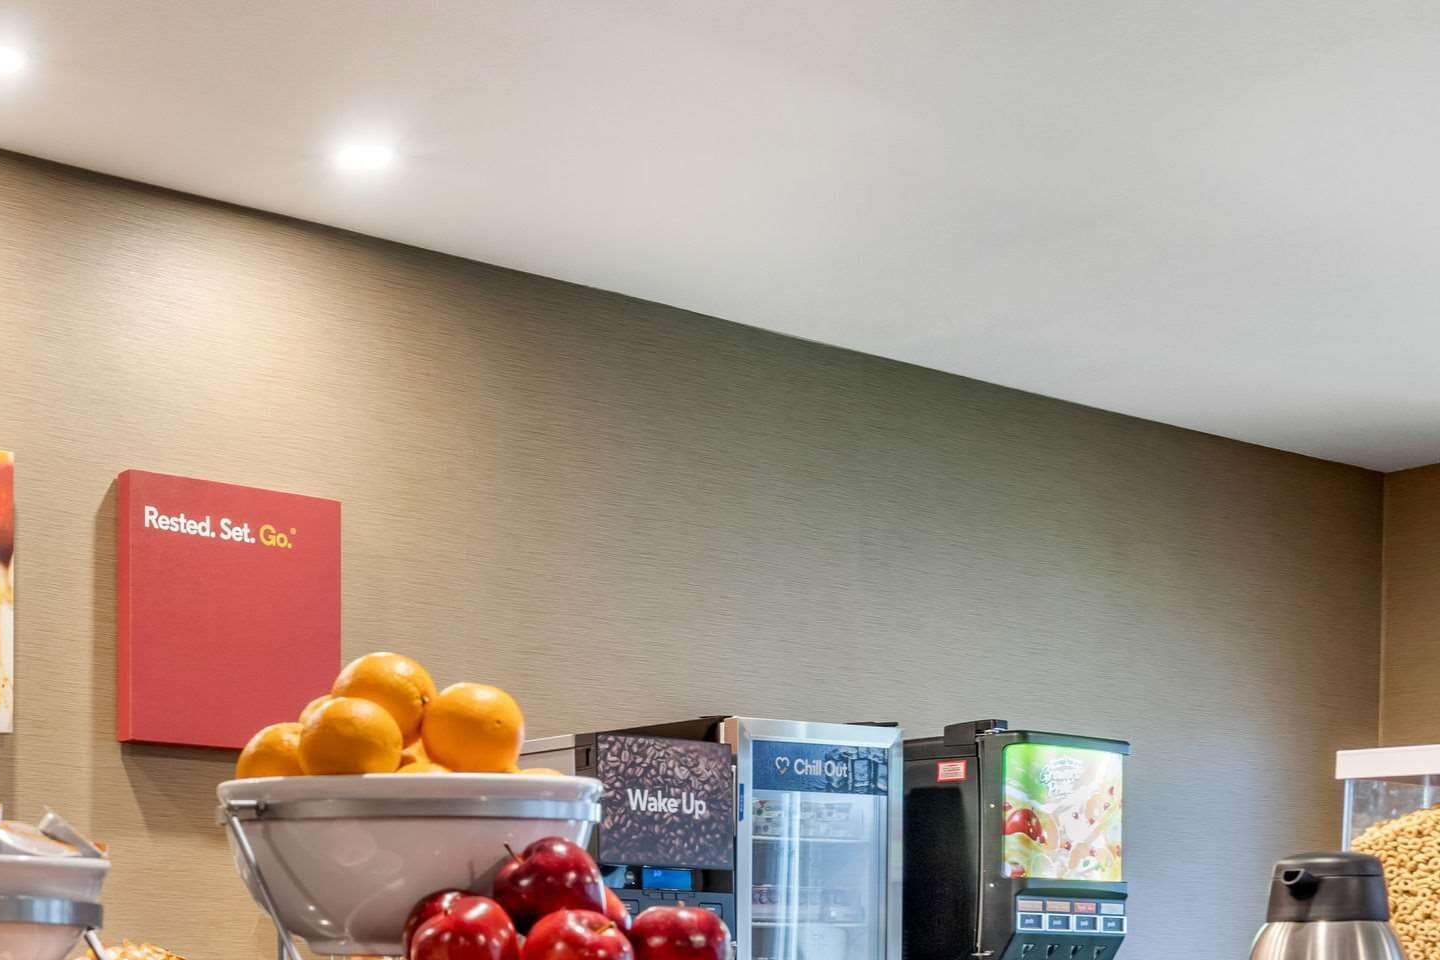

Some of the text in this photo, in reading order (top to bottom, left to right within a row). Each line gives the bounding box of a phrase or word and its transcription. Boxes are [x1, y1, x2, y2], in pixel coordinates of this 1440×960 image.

[144, 505, 217, 539] Rested.
[220, 517, 256, 544] Set.
[793, 757, 848, 778] Chill Out
[626, 787, 679, 814] Wake
[681, 791, 707, 820] Up
